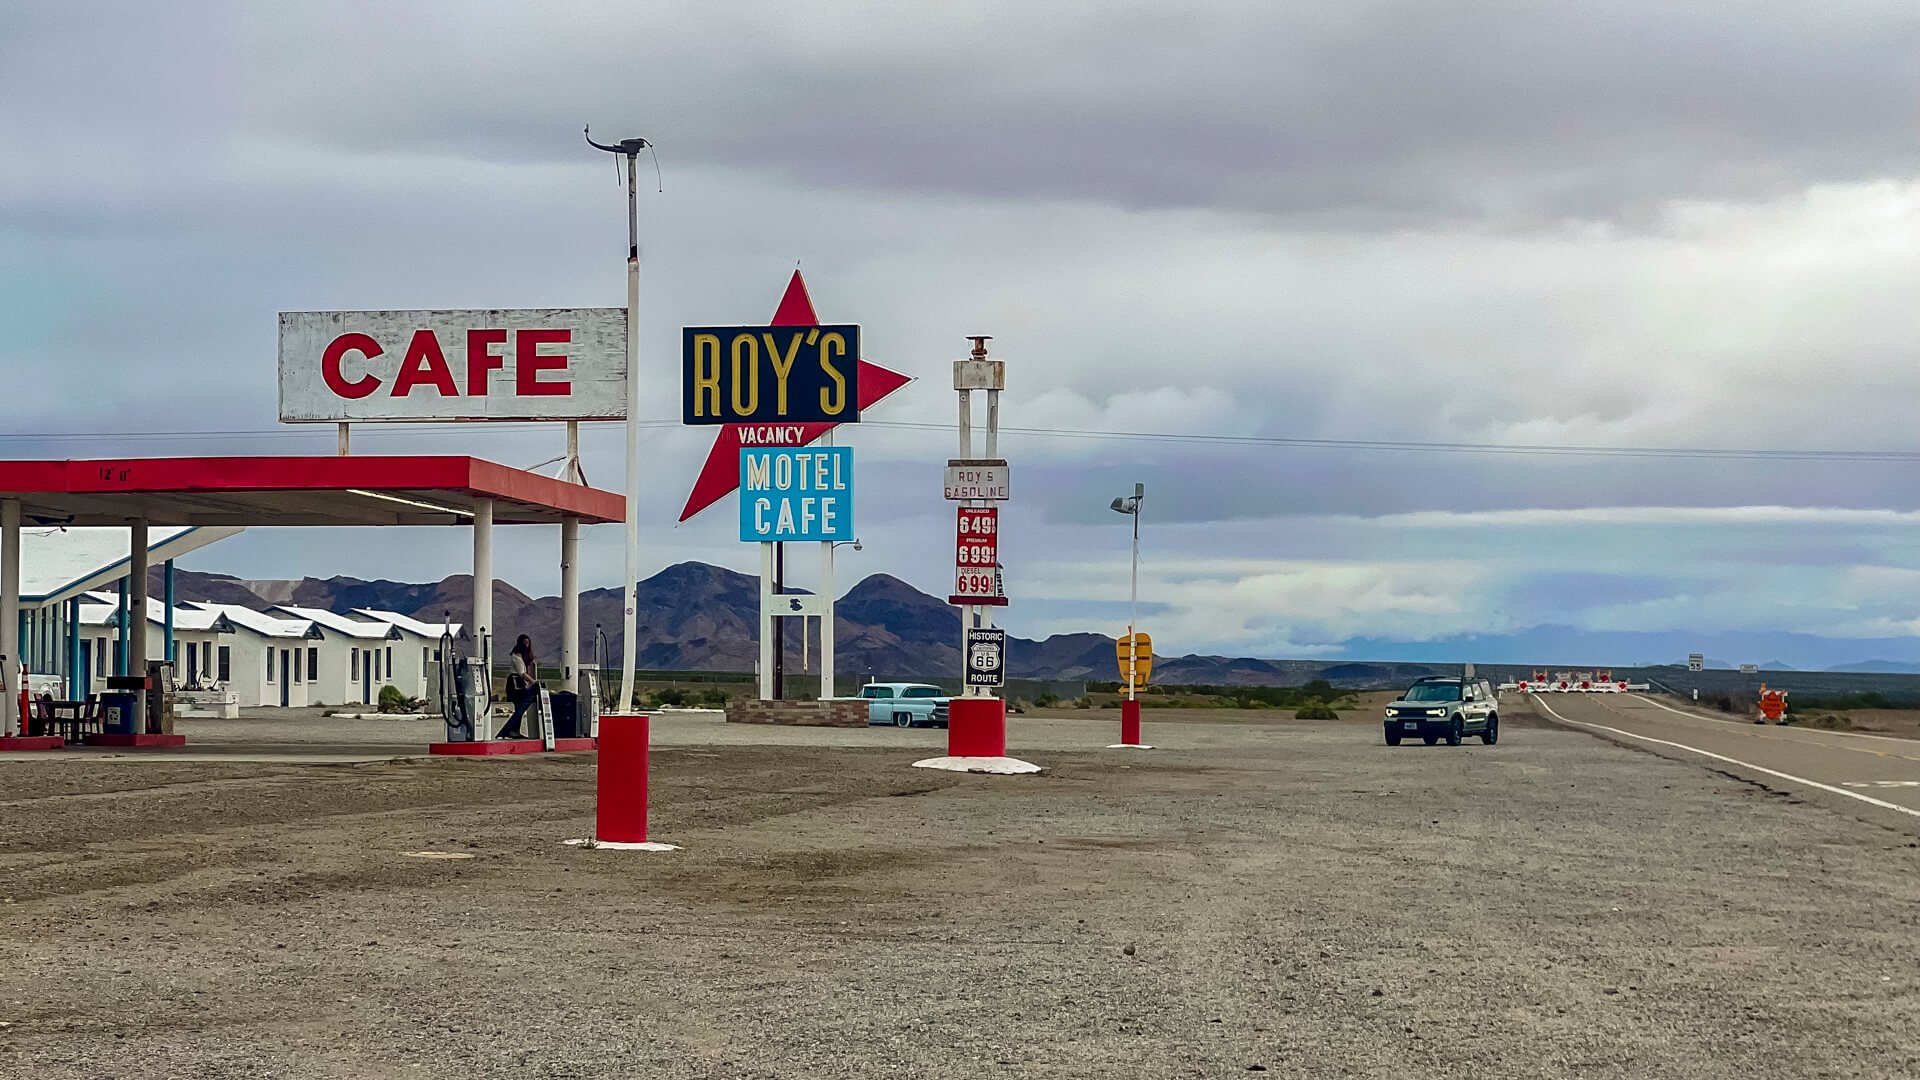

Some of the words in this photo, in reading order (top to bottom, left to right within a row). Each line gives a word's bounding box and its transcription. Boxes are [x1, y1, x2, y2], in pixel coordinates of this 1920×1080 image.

[321, 329, 572, 400] CAFE
[693, 327, 846, 417] ROY'S
[738, 426, 805, 444] VACANCY
[747, 453, 846, 491] MOTEL
[944, 486, 1005, 498] GASOLINE
[754, 497, 836, 535] CAFE
[961, 567, 981, 575] DIESEL
[969, 632, 1003, 641] HISTORIC
[976, 656, 994, 667] 66
[971, 674, 998, 683] ROUTE
